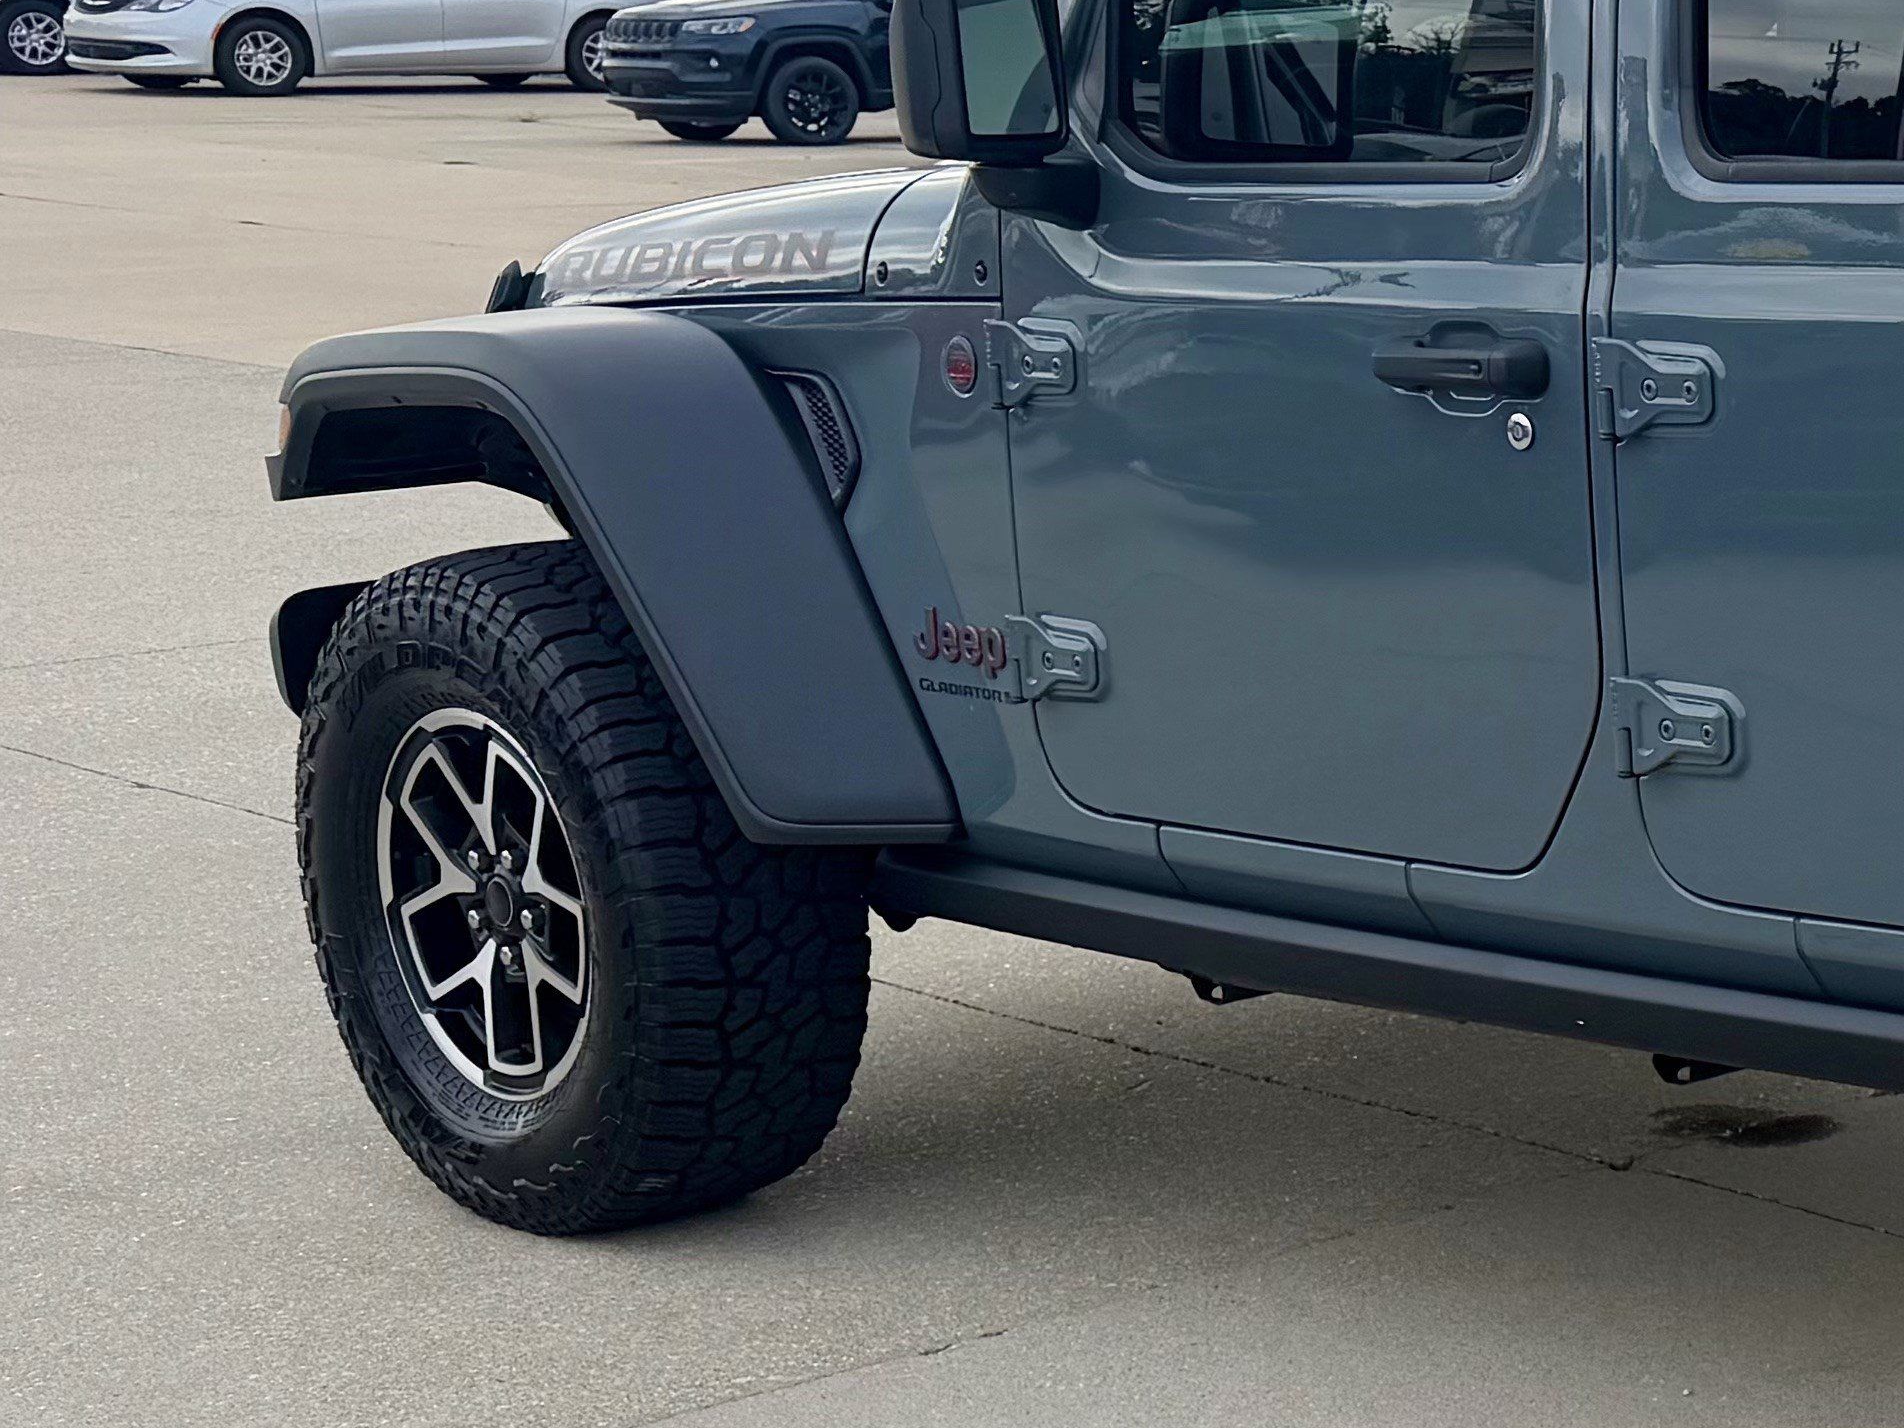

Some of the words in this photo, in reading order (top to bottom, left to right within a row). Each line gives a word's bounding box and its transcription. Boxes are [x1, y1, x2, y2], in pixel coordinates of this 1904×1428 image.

[556, 229, 836, 281] RUBICON
[914, 605, 1008, 680] Jeep
[919, 677, 1003, 703] GLADIATOR
